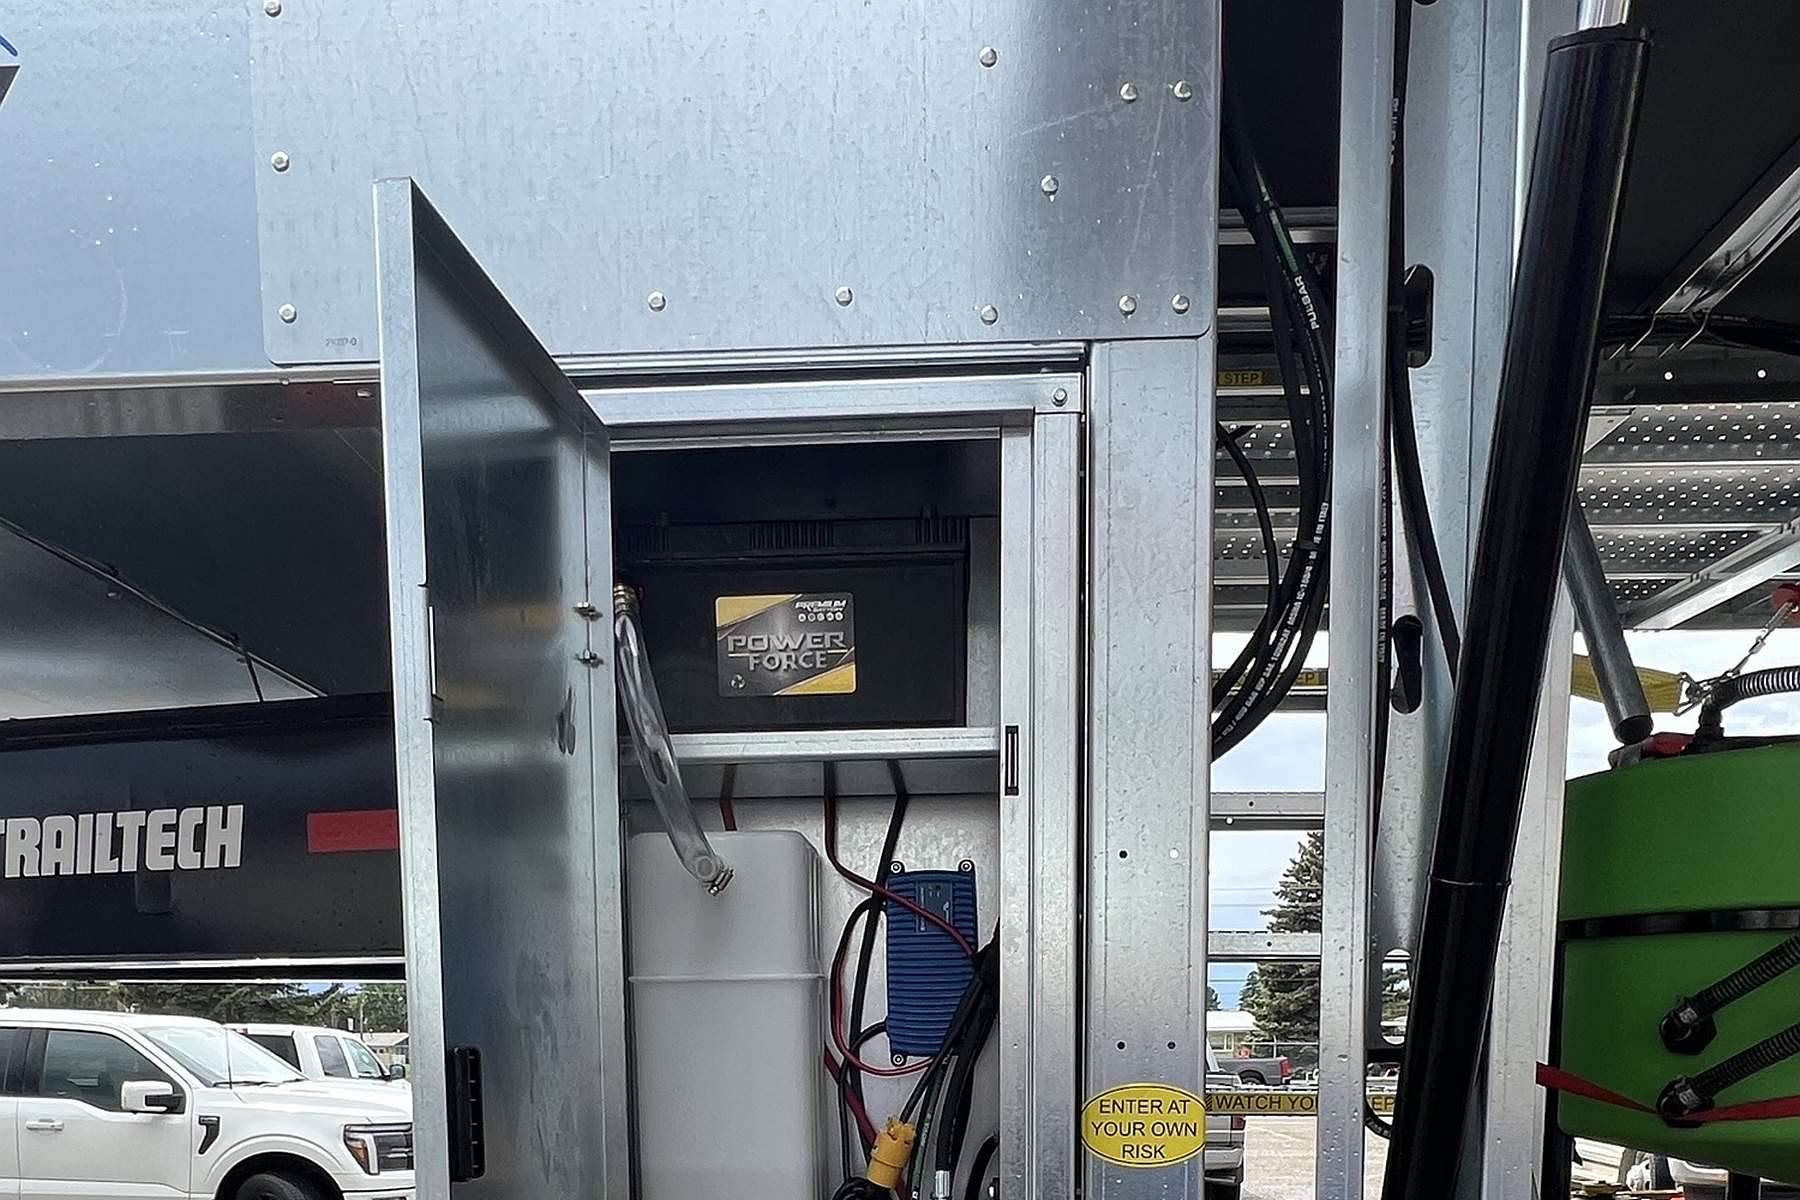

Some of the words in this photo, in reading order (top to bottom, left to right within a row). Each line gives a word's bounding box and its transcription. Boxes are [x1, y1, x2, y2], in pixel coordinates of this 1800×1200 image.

[1294, 275, 1320, 331] PULSAR
[1224, 372, 1260, 385] STEP
[727, 631, 847, 652] POWER
[749, 650, 828, 672] FORCE
[0, 804, 244, 879] RAILTECH
[1099, 1099, 1163, 1115] ENTER
[1167, 1099, 1191, 1115] AT
[1216, 1096, 1278, 1110] WATCH
[1287, 1095, 1318, 1111] YO
[1091, 1121, 1146, 1137] YOUR
[1151, 1121, 1198, 1137] OWN
[1121, 1143, 1166, 1159] RISK
